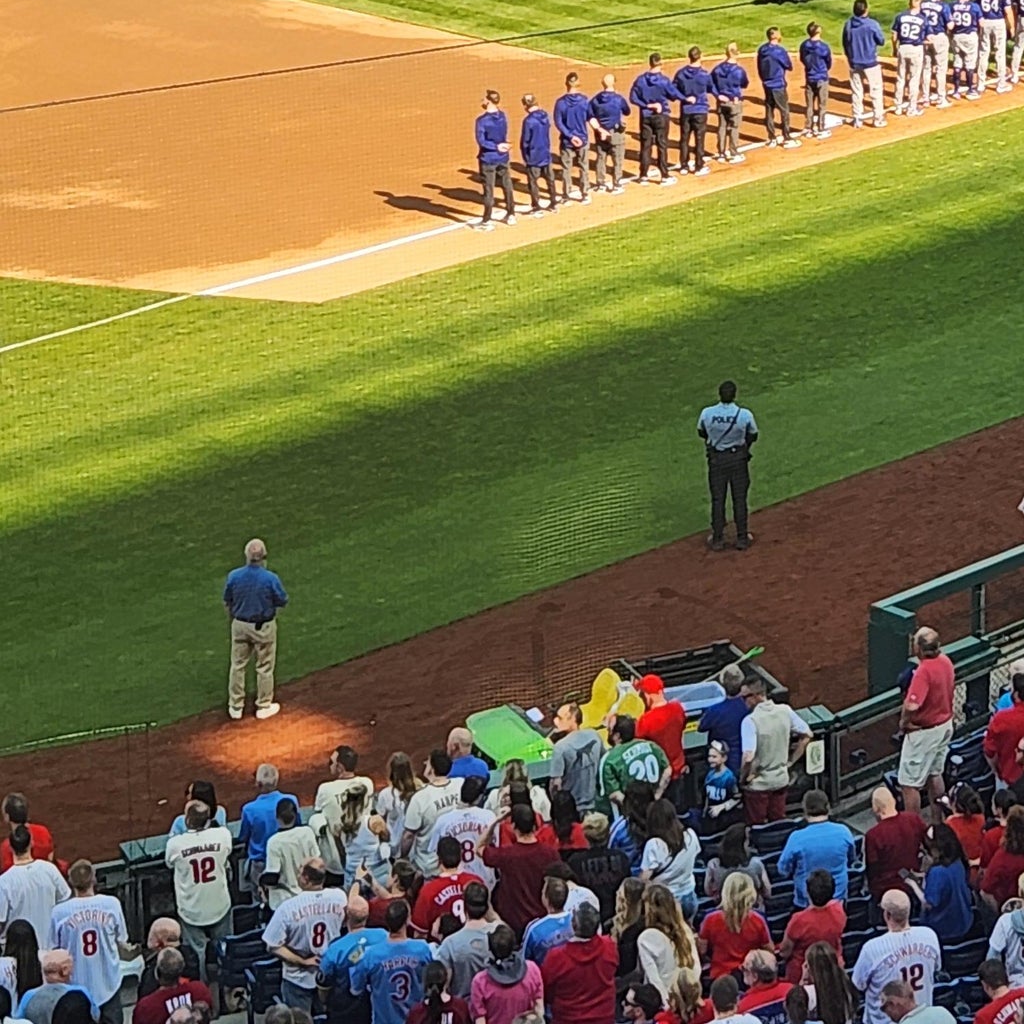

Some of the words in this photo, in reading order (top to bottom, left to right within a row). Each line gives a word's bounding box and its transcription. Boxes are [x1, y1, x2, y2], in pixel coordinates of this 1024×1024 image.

[900, 23, 921, 40] 82
[628, 753, 660, 784] 20
[433, 793, 460, 811] HARPE
[461, 839, 475, 864] 8
[189, 855, 218, 886] 12
[81, 929, 98, 957] 8
[312, 921, 328, 949] 8
[389, 969, 412, 1002] 3
[899, 962, 924, 992] 12
